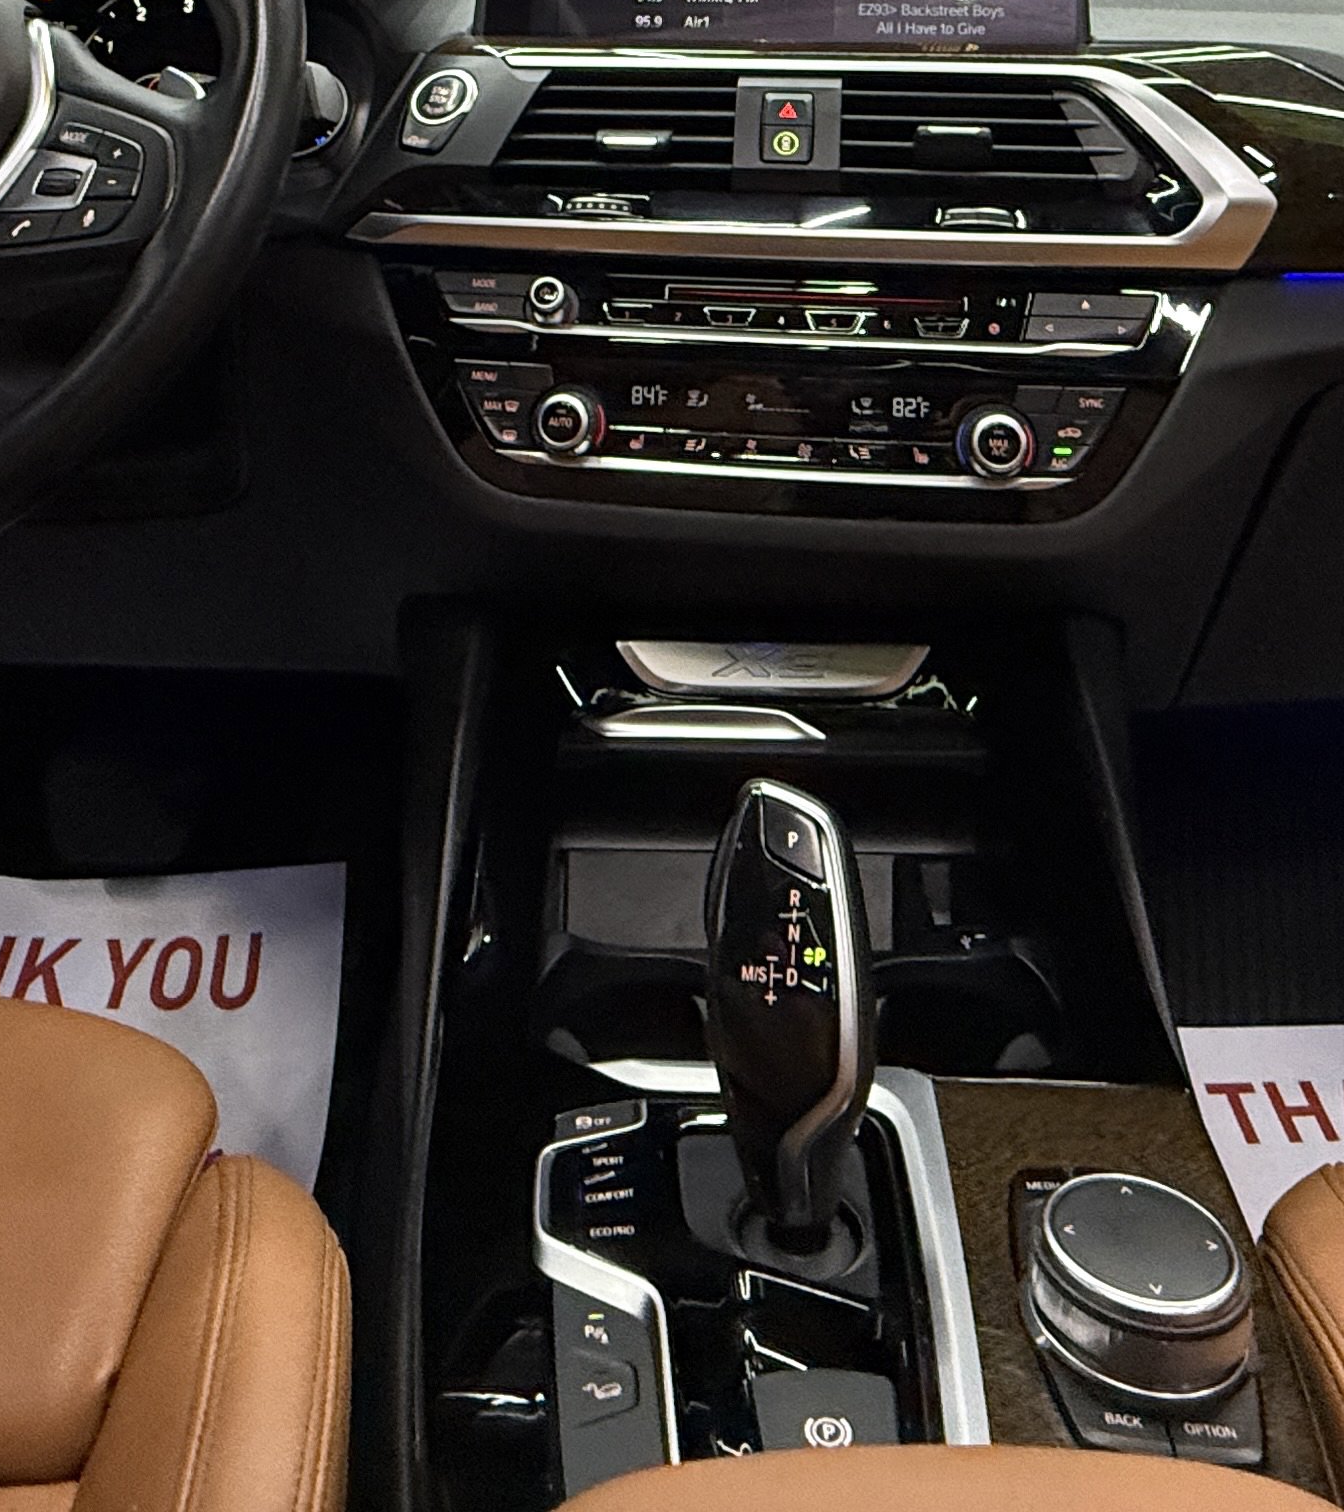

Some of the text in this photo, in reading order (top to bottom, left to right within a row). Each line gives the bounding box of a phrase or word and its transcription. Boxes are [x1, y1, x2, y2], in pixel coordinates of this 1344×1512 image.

[135, 6, 148, 22] 2
[857, 3, 1005, 19] EZ93> Backstreet Boys
[635, 15, 663, 27] 95.9
[876, 23, 894, 34] All
[905, 23, 937, 34] Have
[940, 24, 954, 35] to
[957, 24, 986, 35] Give
[107, 40, 114, 54] 1
[470, 370, 498, 382] MENU
[1077, 396, 1106, 410] SYNC
[547, 416, 574, 428] AUTO
[787, 831, 799, 849] P
[789, 889, 802, 907] R
[788, 923, 801, 943] N
[814, 947, 827, 967] P
[104, 932, 264, 1011] YOU
[741, 964, 768, 985] M/S
[786, 968, 799, 987] D
[584, 1187, 635, 1204] COMFORT
[589, 1224, 636, 1239] ECO PRO
[1104, 1411, 1144, 1429] BACK
[1184, 1422, 1238, 1440] OPTION
